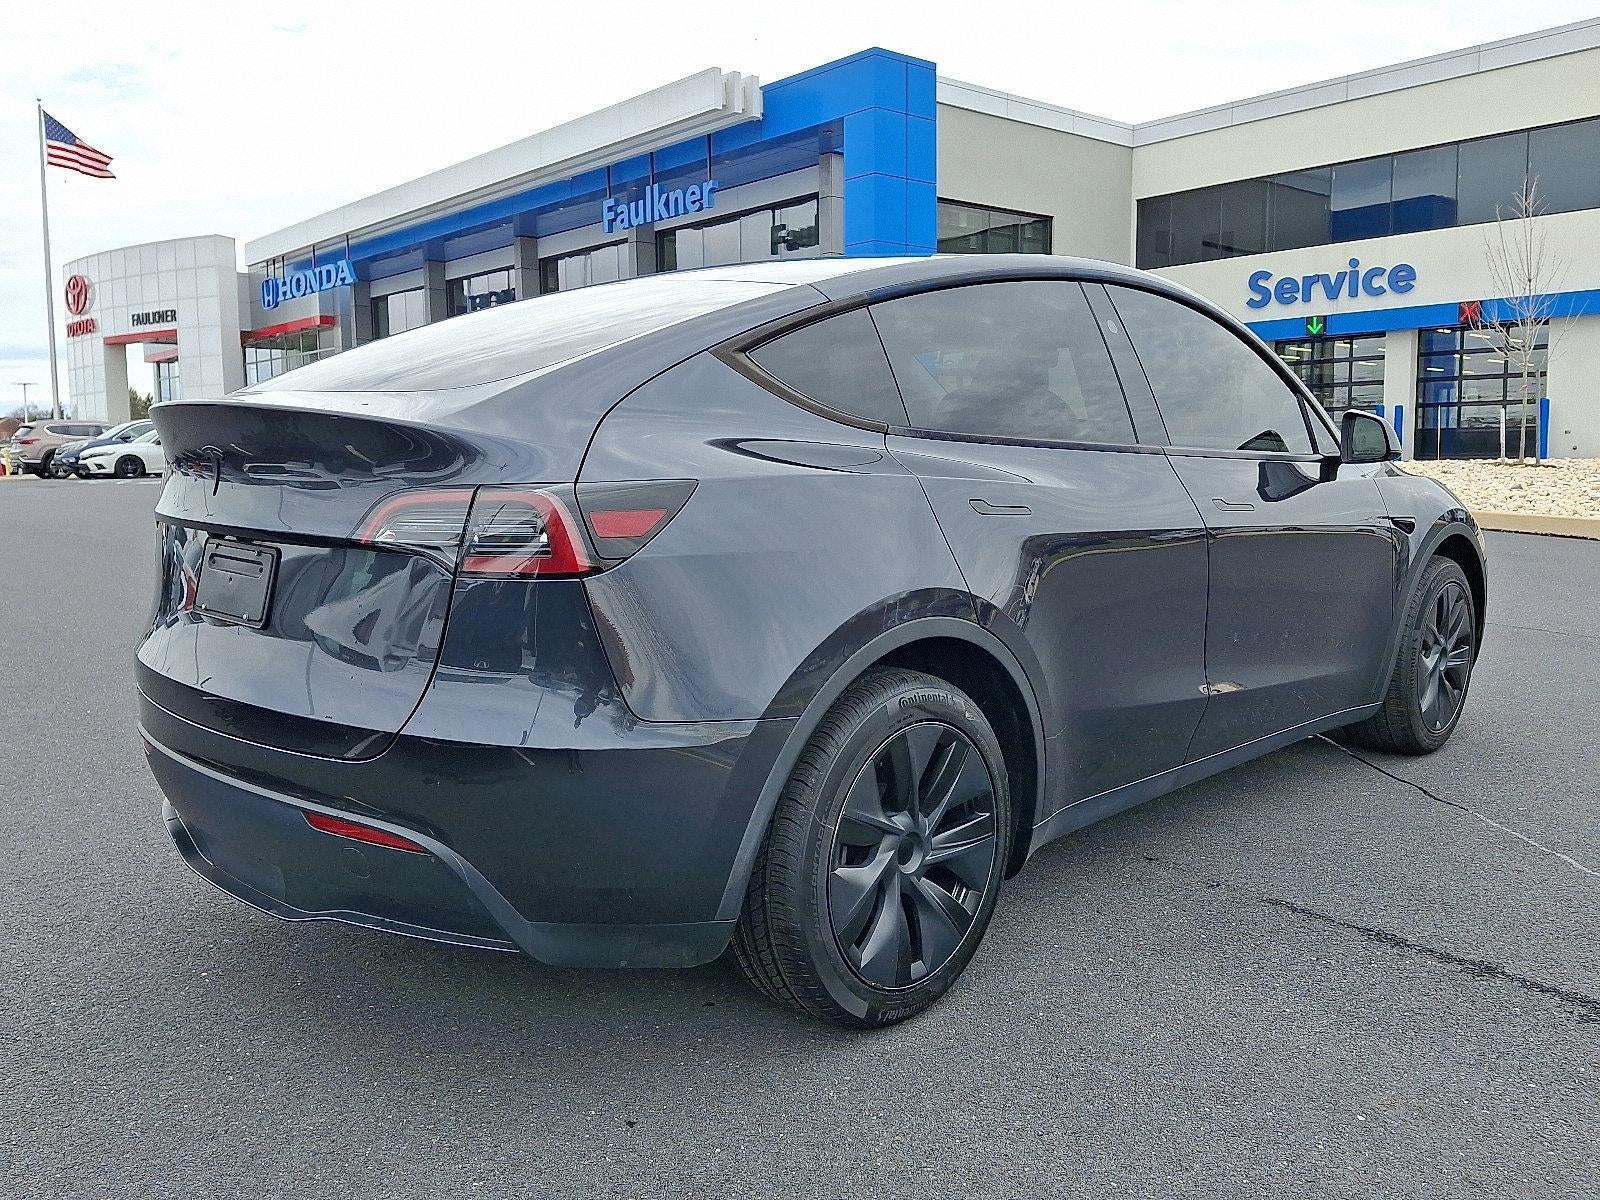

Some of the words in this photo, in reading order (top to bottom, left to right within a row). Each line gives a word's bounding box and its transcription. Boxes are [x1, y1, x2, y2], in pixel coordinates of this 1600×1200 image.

[602, 179, 718, 232] Faulkner
[277, 259, 356, 302] HONDA
[1246, 258, 1417, 308] Service
[66, 319, 95, 337] TOYOTA
[131, 309, 177, 326] FAULKNER
[898, 691, 949, 708] Continental
